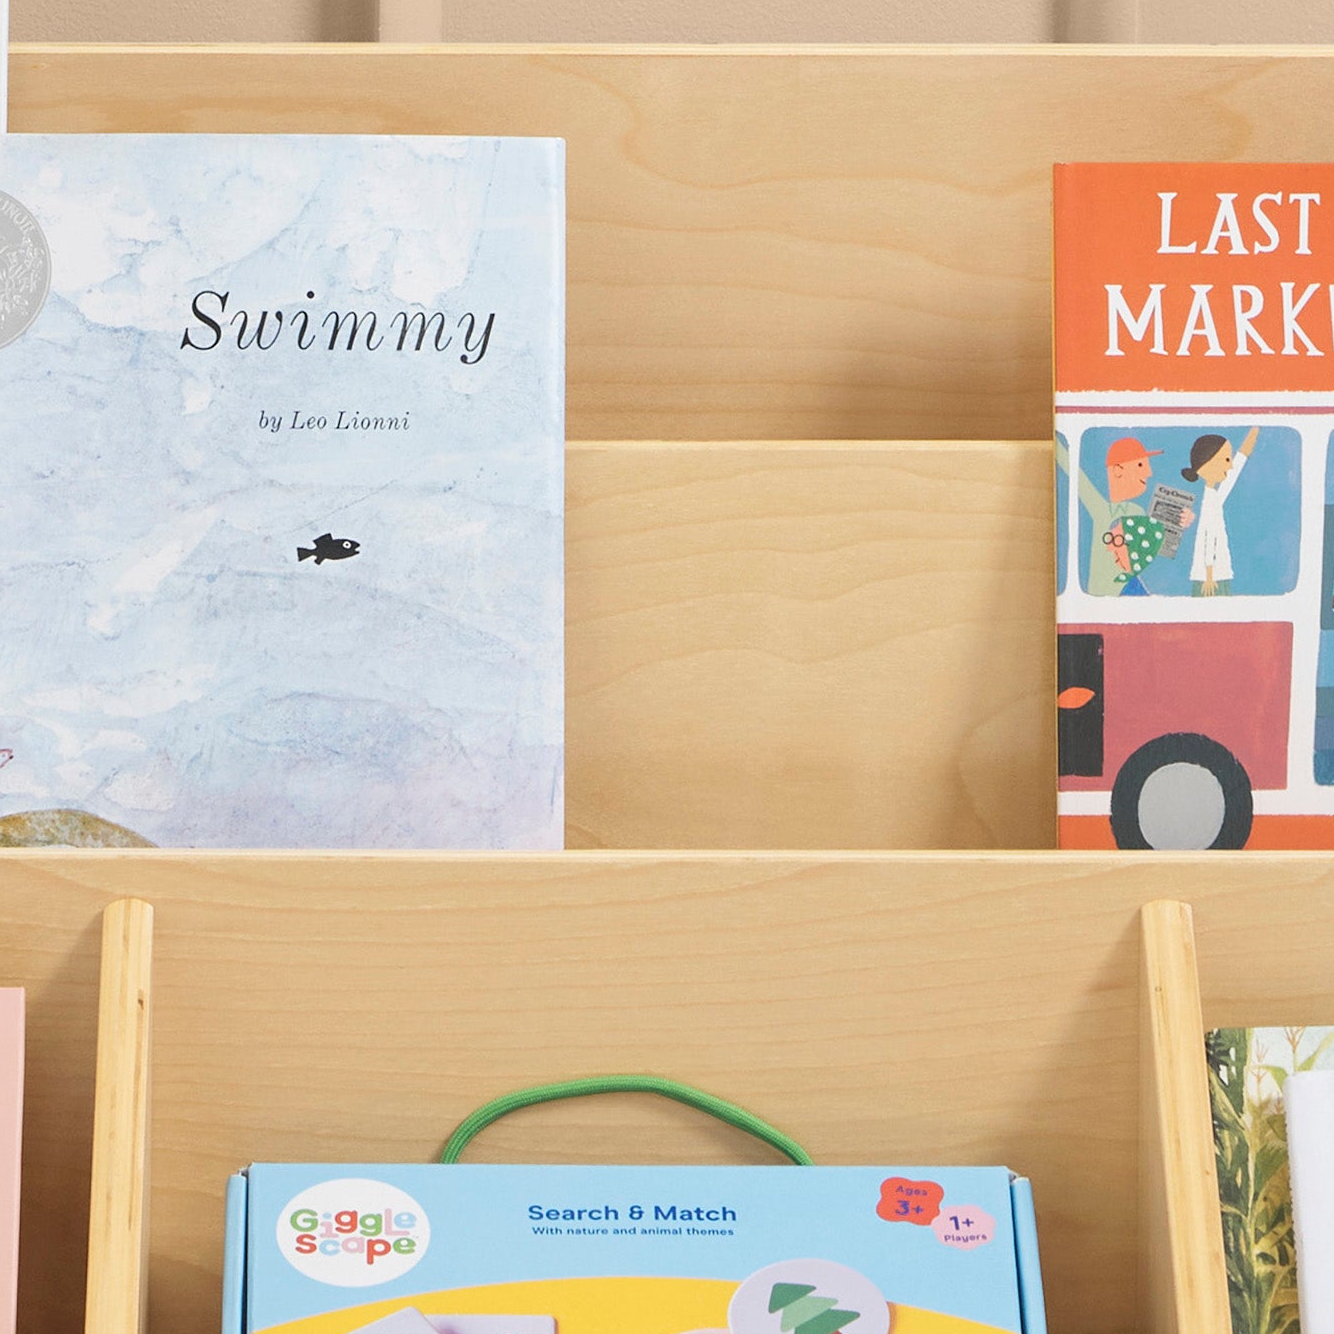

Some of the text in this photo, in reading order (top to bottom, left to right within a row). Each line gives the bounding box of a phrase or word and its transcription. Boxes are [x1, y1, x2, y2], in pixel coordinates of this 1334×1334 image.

[1156, 191, 1322, 257] LAST
[180, 290, 497, 366] Swimmy
[258, 410, 411, 434] by Leo Lionni
[895, 1185, 929, 1197] Ages
[528, 1205, 738, 1222] Search & Match
[895, 1199, 924, 1216] 3+
[532, 1226, 735, 1237] With nature and animal themes
[949, 1215, 975, 1231] 1+
[943, 1233, 988, 1243] Players
